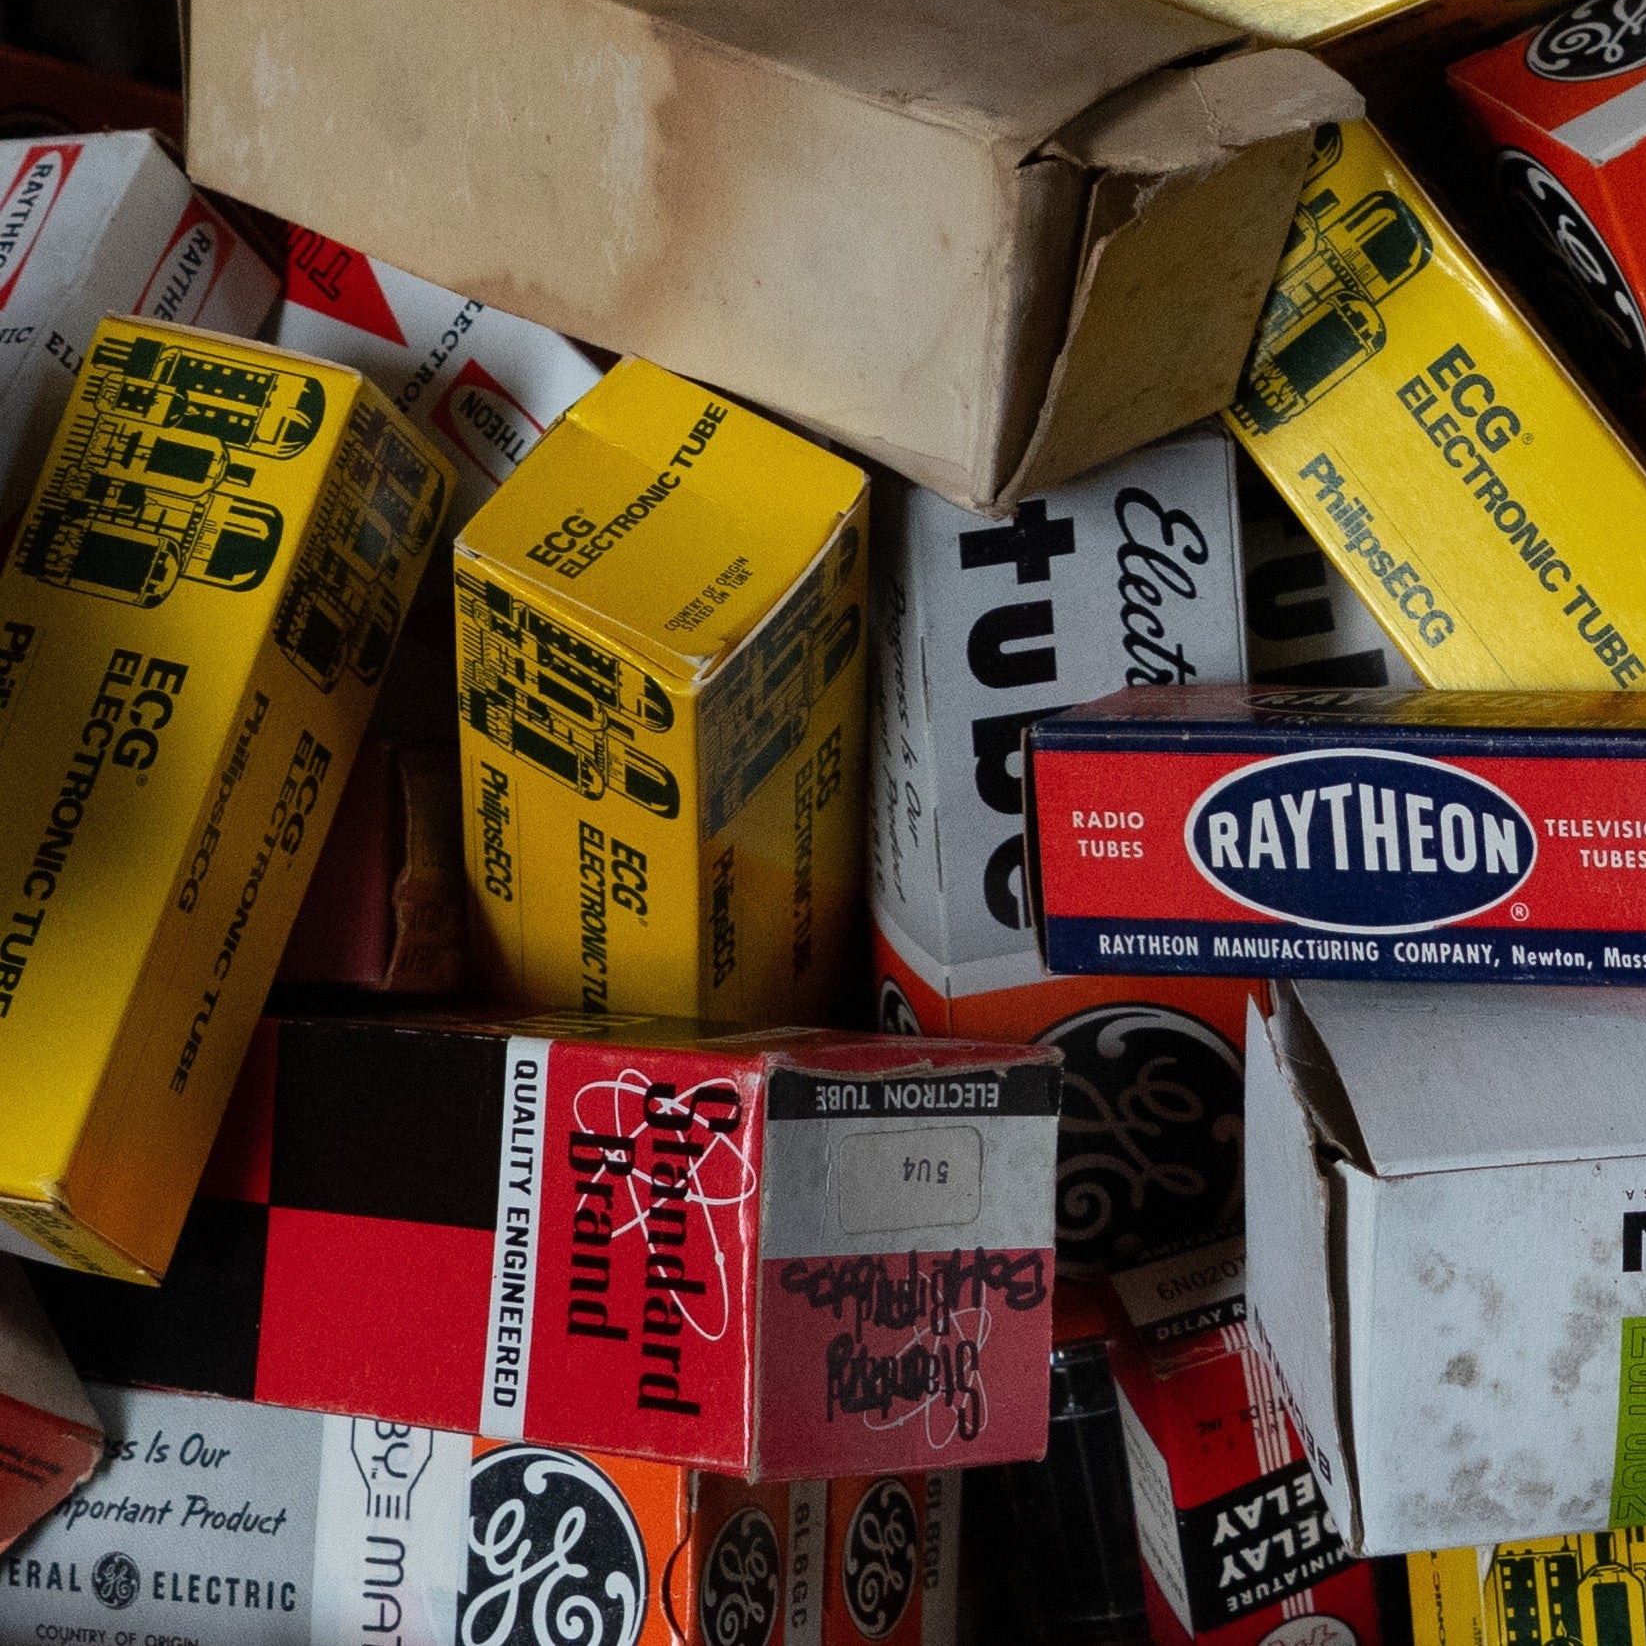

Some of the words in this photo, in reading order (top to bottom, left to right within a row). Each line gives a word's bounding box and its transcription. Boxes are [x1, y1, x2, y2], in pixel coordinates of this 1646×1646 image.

[1425, 343, 1522, 453] ECG
[526, 513, 598, 568] ECG
[556, 472, 682, 579] ELECTRONIC
[669, 402, 729, 475] TUBE
[1396, 374, 1572, 594] ELECTRONIC
[1562, 583, 1646, 691] TUBE
[664, 597, 704, 631] COUNTRY
[715, 556, 749, 586] ORIGIN
[681, 605, 715, 632] STATED
[713, 591, 730, 604] ON
[727, 569, 753, 589] TUBE
[1298, 451, 1455, 649] PhilipsECG
[112, 657, 189, 772] ECG
[24, 648, 143, 902] ELECTRONIC
[178, 690, 271, 914] PhilipsECG
[282, 739, 331, 856] ECG
[1072, 810, 1145, 831] RADIO
[1206, 782, 1520, 875] RAYTHEON
[216, 729, 316, 988] ELECTRONIC
[480, 761, 513, 904] PhilipsECG
[610, 836, 649, 919] ECG
[1077, 839, 1144, 860] TUBES
[578, 819, 608, 957] ELECTRONIC
[1098, 933, 1200, 958] RAYTHEON
[1212, 938, 1381, 963] MANUFACTURING
[1394, 942, 1500, 968] COMPANY,
[1511, 945, 1594, 971] Newton,
[169, 988, 218, 1096] TUBE
[881, 1081, 999, 1110] ELECTRON
[512, 1058, 539, 1198] QUALITY
[814, 1086, 872, 1111] TUBE
[902, 1155, 950, 1185] 5U4
[565, 1129, 635, 1344] Brand
[636, 1080, 744, 1416] Standard
[492, 1206, 530, 1409] ENGINEERED
[146, 1430, 169, 1465] Is
[180, 1433, 230, 1468] Our
[182, 1494, 287, 1537] Product
[35, 1623, 107, 1645] COUNTRY
[152, 1572, 296, 1612] ELECTRIC
